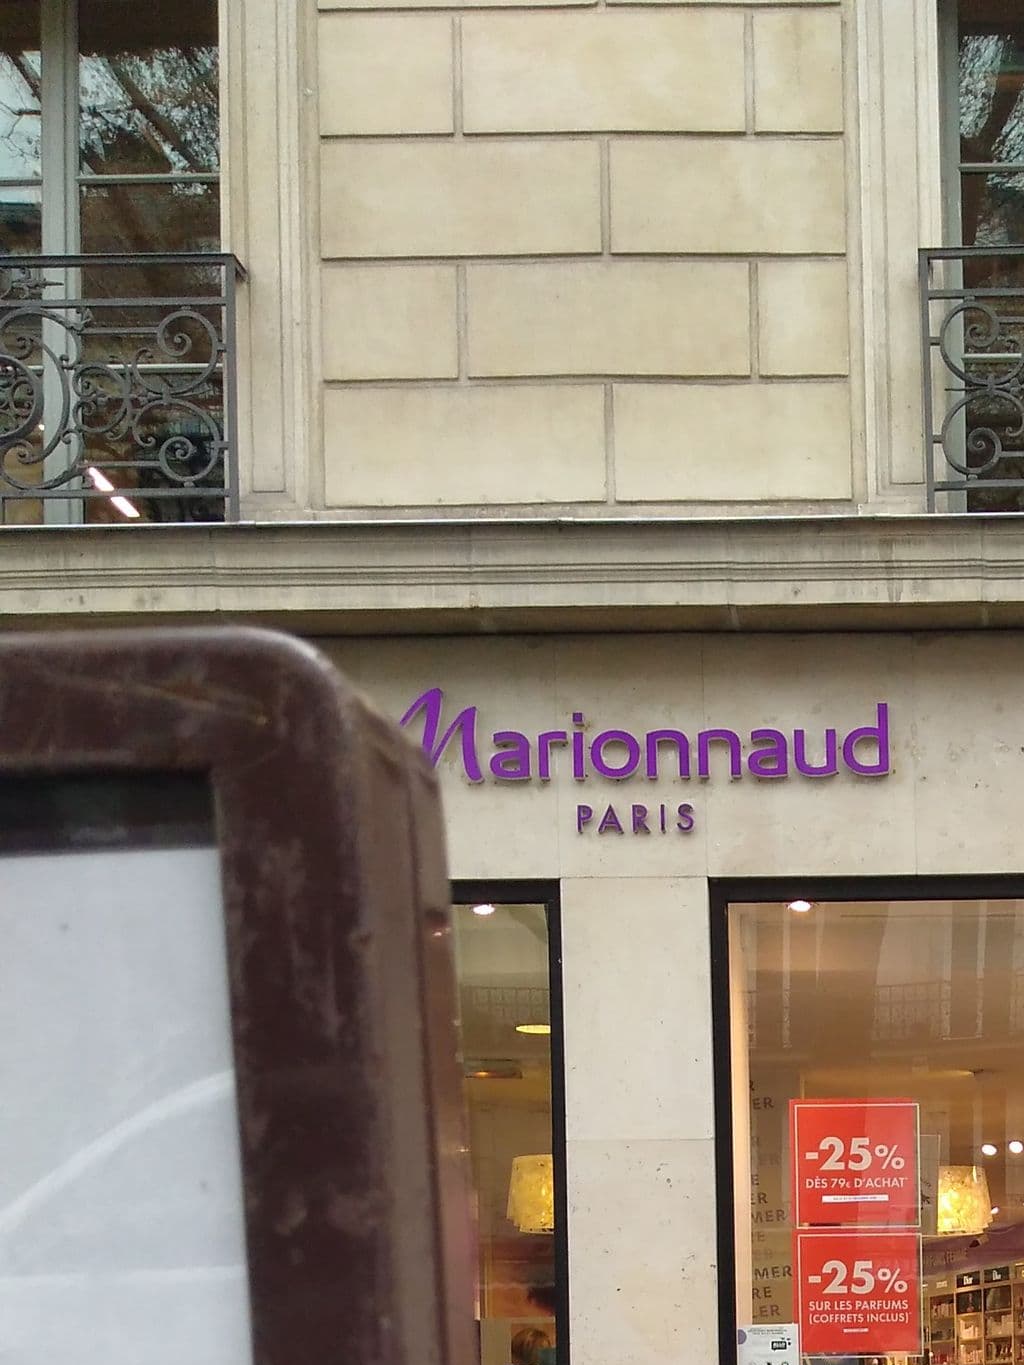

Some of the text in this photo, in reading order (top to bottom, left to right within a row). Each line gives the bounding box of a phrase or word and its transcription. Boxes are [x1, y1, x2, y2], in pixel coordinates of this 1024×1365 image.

[400, 688, 891, 784] Marionnaud
[576, 804, 696, 834] PARIS
[805, 1136, 905, 1172] -25%
[807, 1259, 909, 1295] -25%
[808, 1299, 909, 1312] SUR LES PARFUMS
[808, 1312, 864, 1325] (COFFRETS
